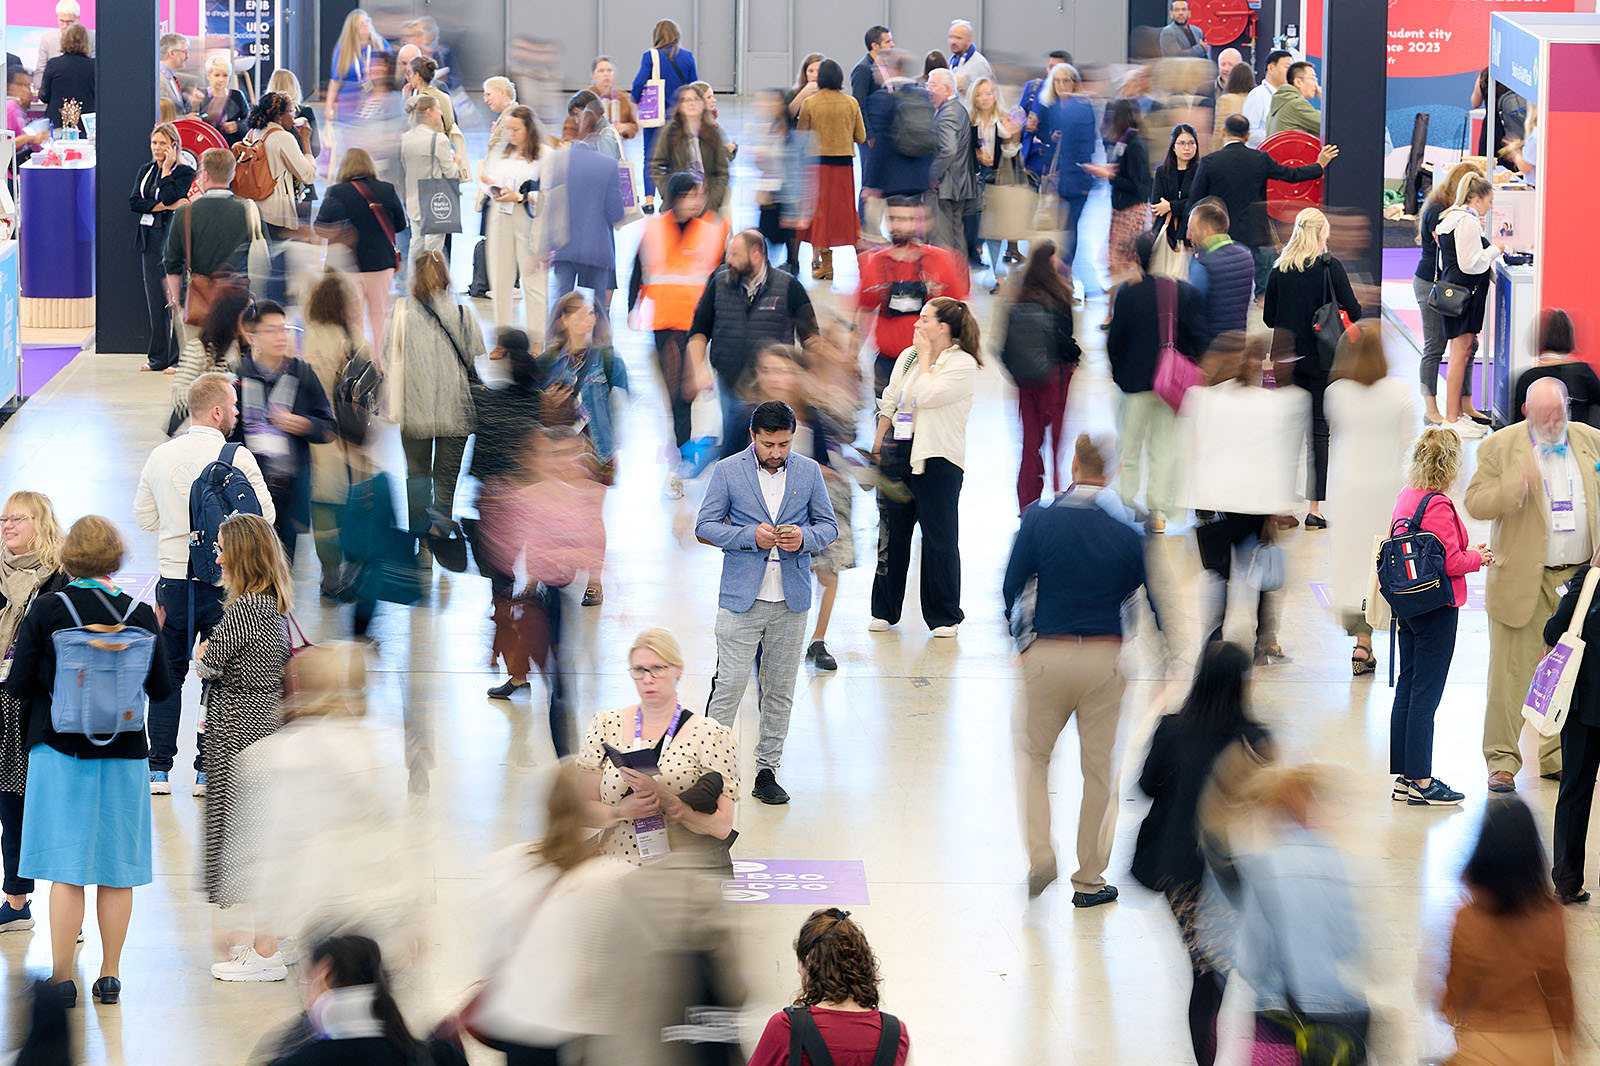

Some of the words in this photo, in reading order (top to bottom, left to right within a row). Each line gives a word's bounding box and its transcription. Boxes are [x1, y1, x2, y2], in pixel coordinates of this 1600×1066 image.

[1387, 28, 1425, 39] udent
[1428, 28, 1452, 42] city
[1408, 42, 1441, 53] 2023
